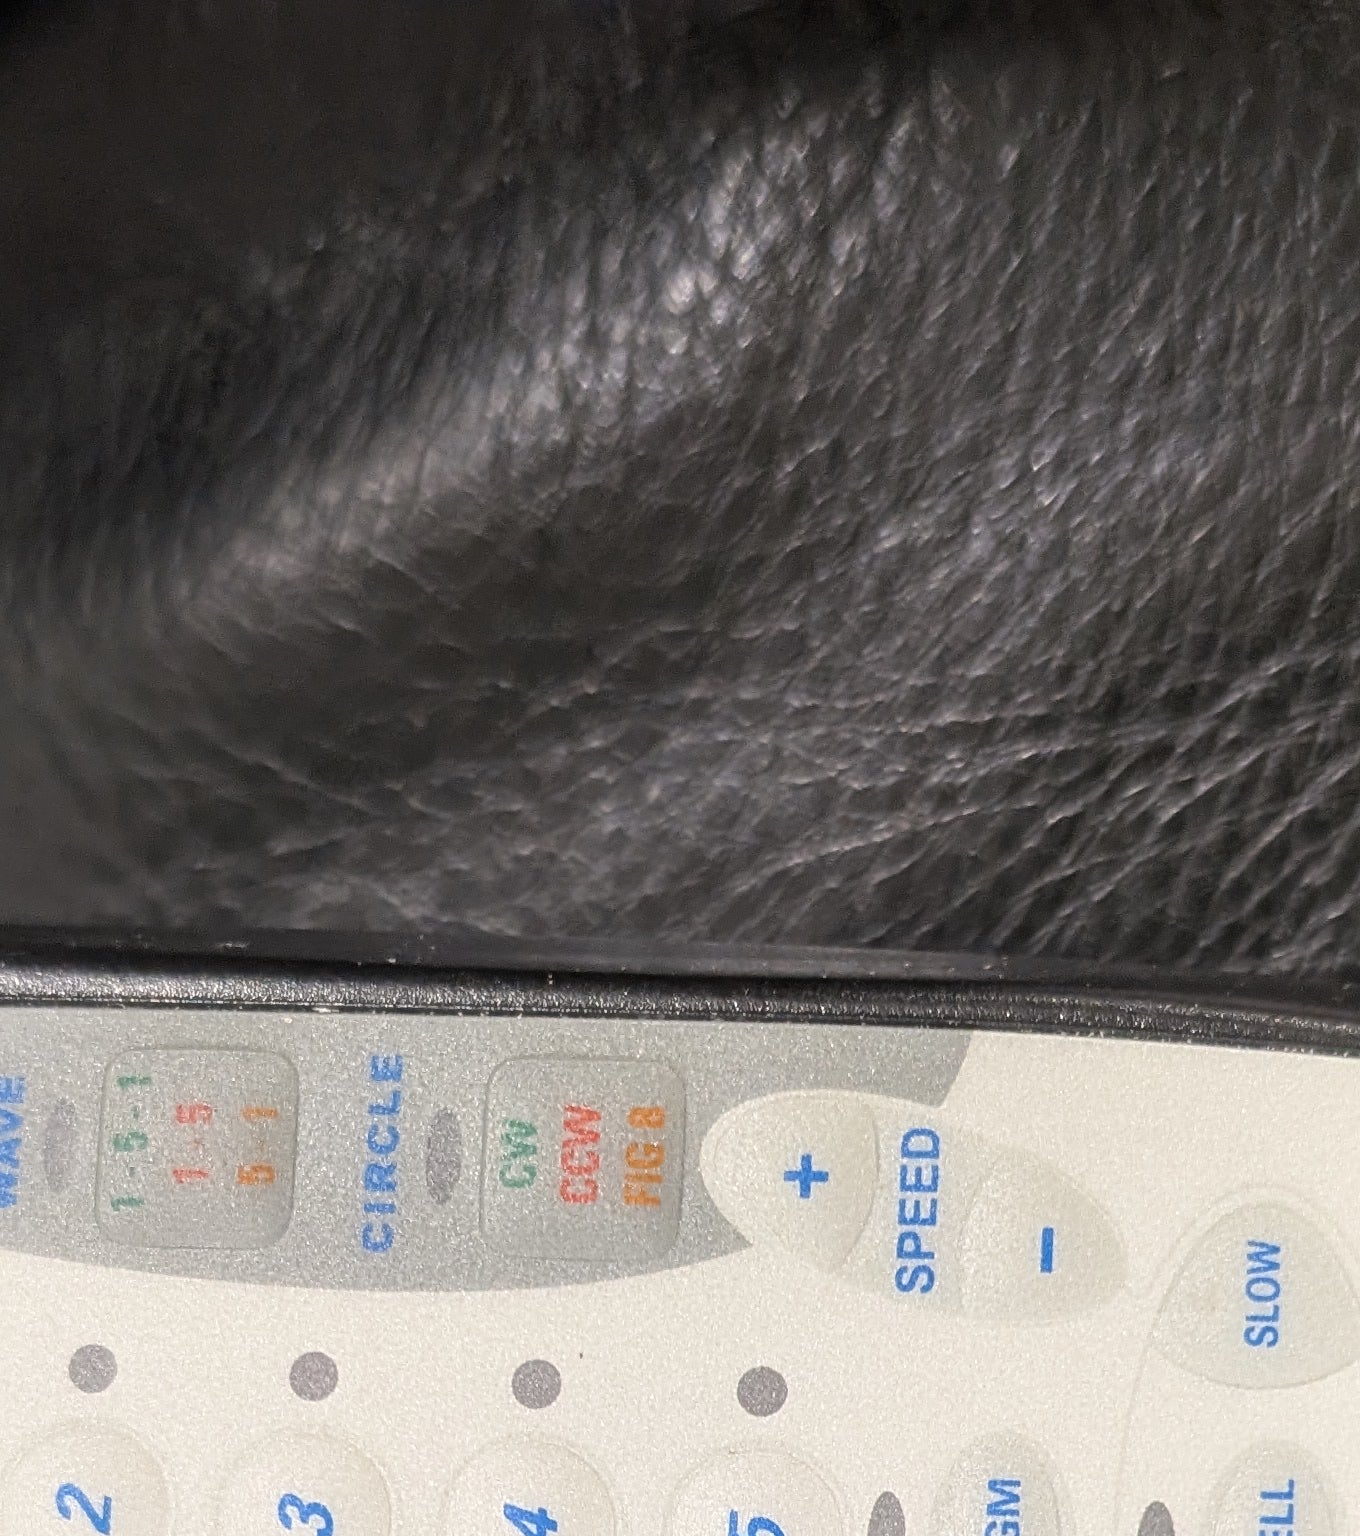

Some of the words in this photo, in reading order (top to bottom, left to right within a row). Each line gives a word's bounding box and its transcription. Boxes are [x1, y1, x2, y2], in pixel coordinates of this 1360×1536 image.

[362, 1055, 403, 1253] CIRCLE
[499, 1119, 538, 1188] CW
[560, 1104, 602, 1204] CCW
[627, 1106, 667, 1129] 8
[623, 1142, 666, 1207] FIG
[895, 1128, 942, 1294] SPEED
[1244, 1242, 1283, 1348] SLOW
[57, 1484, 112, 1536] 2
